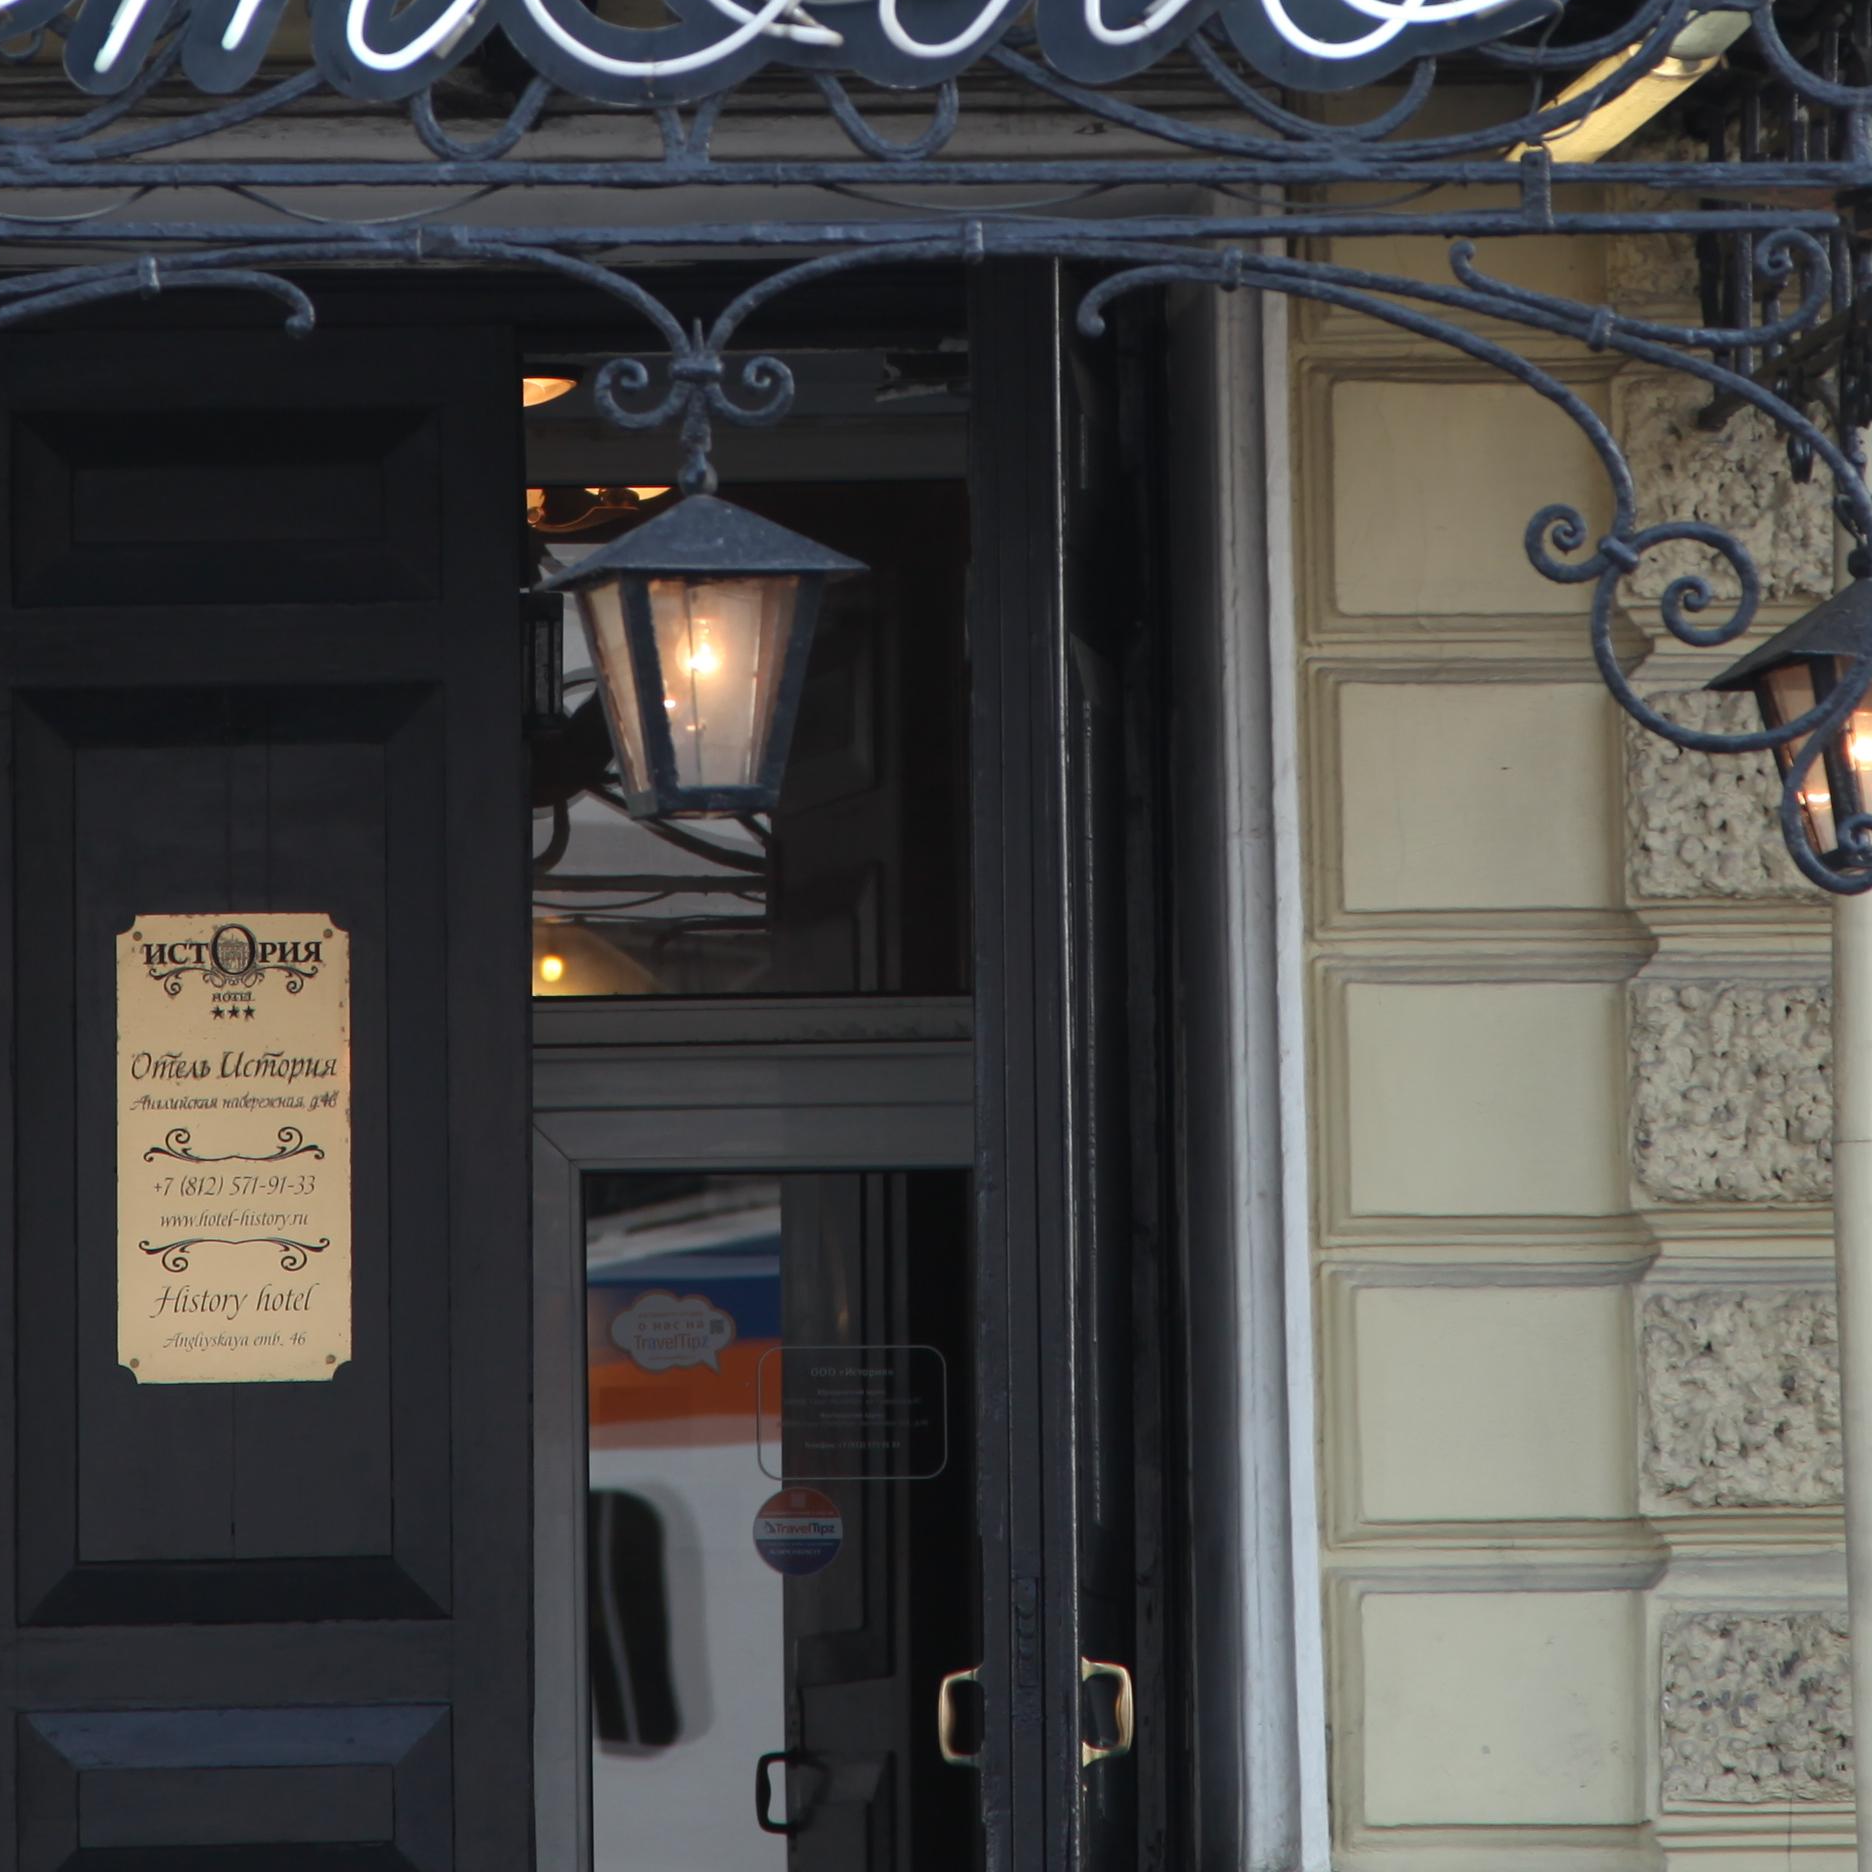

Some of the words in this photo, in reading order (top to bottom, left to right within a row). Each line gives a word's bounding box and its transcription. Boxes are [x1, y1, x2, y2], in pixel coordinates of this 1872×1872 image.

[142, 923, 323, 975] ИСТОРИЯ
[211, 991, 255, 1003] HOTEL
[131, 1051, 211, 1080] Отель
[216, 1051, 337, 1083] История
[154, 1176, 174, 1196] +7
[180, 1175, 224, 1197] (812)
[229, 1175, 316, 1196] 571-91-33
[159, 1208, 309, 1231] www.hotel-history.ru
[149, 1284, 248, 1321] History
[255, 1282, 320, 1312] hotel
[162, 1331, 249, 1353] Angliyskaya
